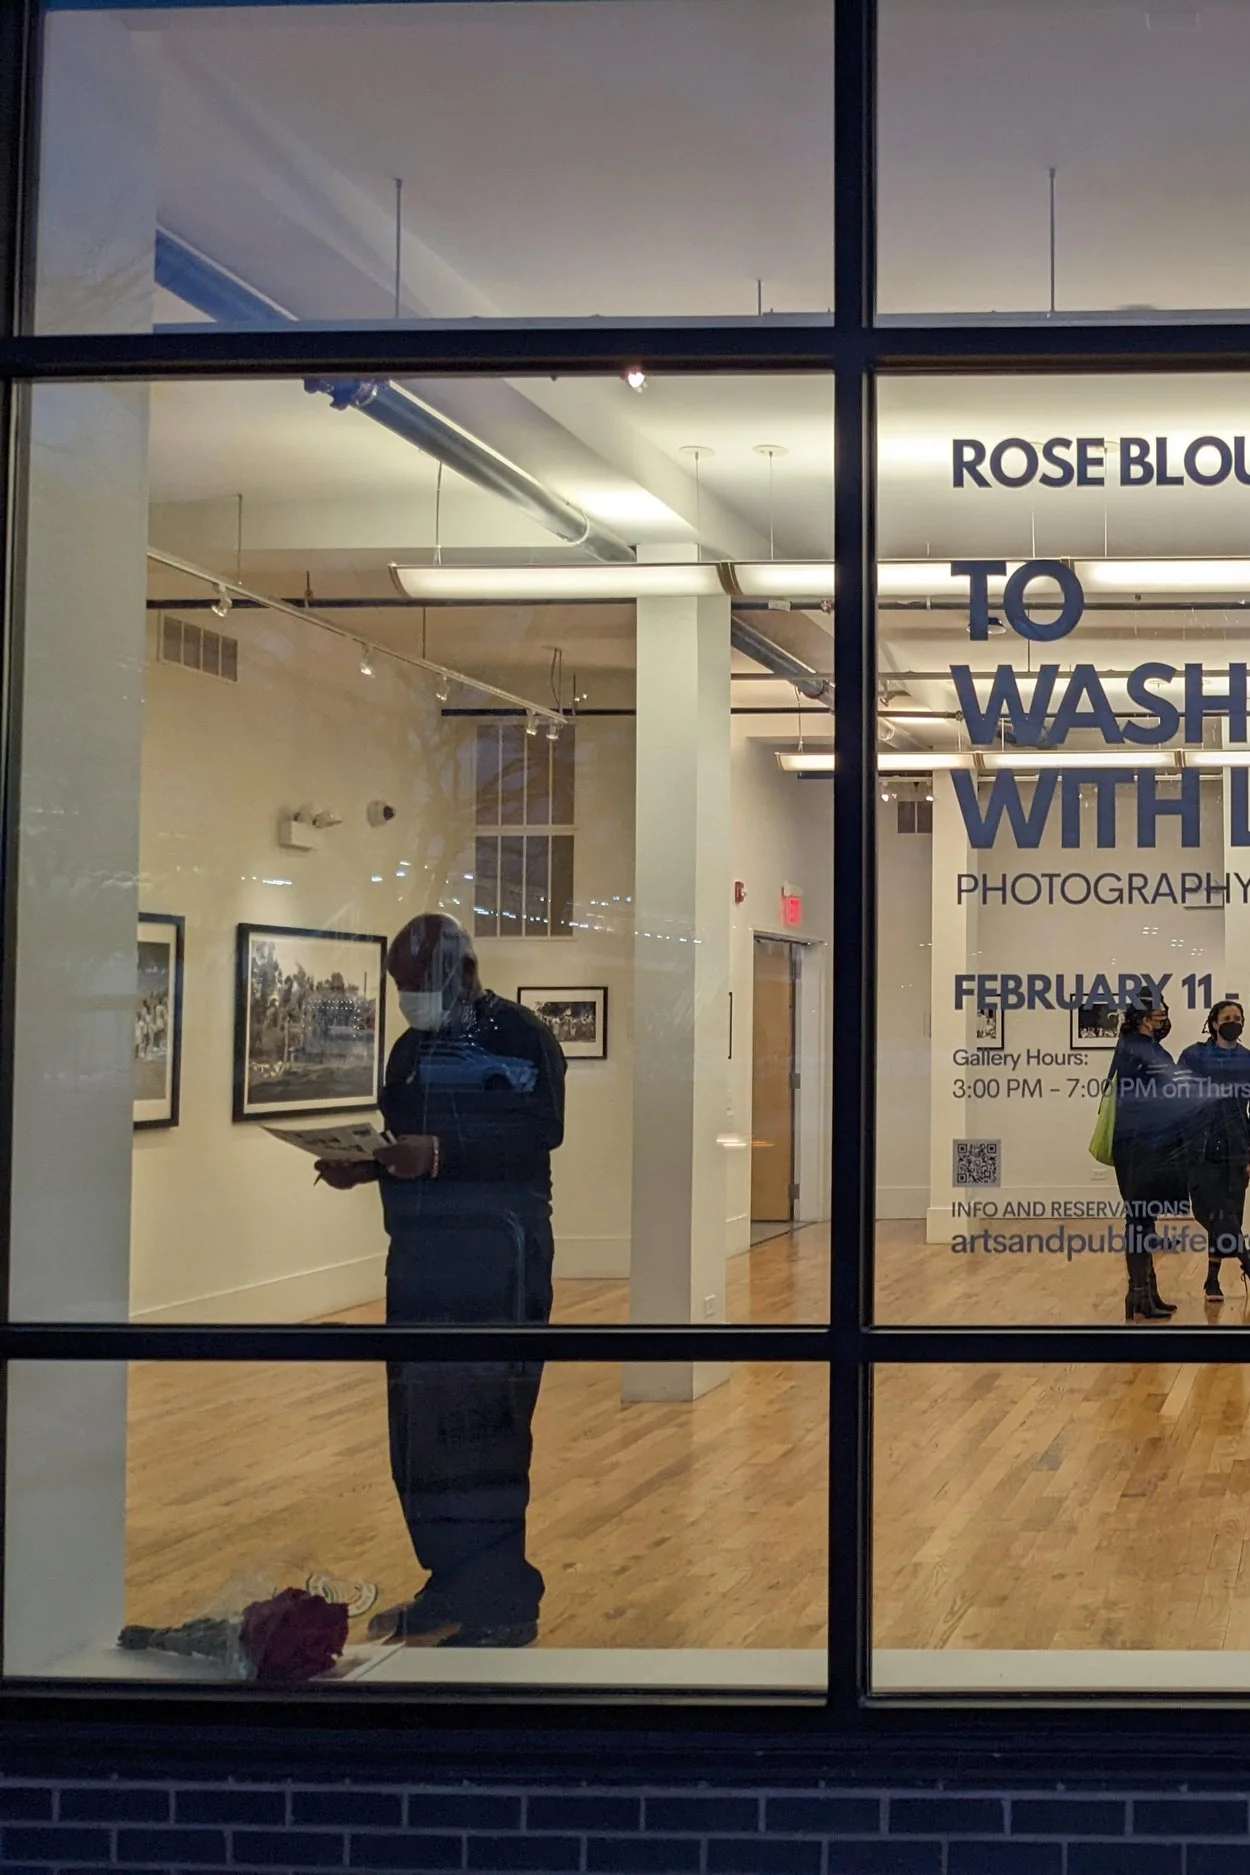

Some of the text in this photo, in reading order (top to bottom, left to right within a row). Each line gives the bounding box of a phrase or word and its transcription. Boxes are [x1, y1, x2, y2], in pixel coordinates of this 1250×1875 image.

[952, 437, 1105, 488] ROSE
[950, 559, 1084, 642] TO
[951, 767, 1200, 849] WITH
[953, 973, 1173, 1010] FEBRUARY
[1181, 973, 1212, 1009] 11
[952, 1049, 1089, 1070] Gallery Hours:
[952, 1079, 1000, 1098] 3:00
[1006, 1079, 1043, 1098] PM
[1067, 1078, 1112, 1098] 7:00
[1119, 1078, 1157, 1098] PM
[1165, 1083, 1190, 1098] on
[951, 1200, 1191, 1217] INFO AND RESERVATIONS
